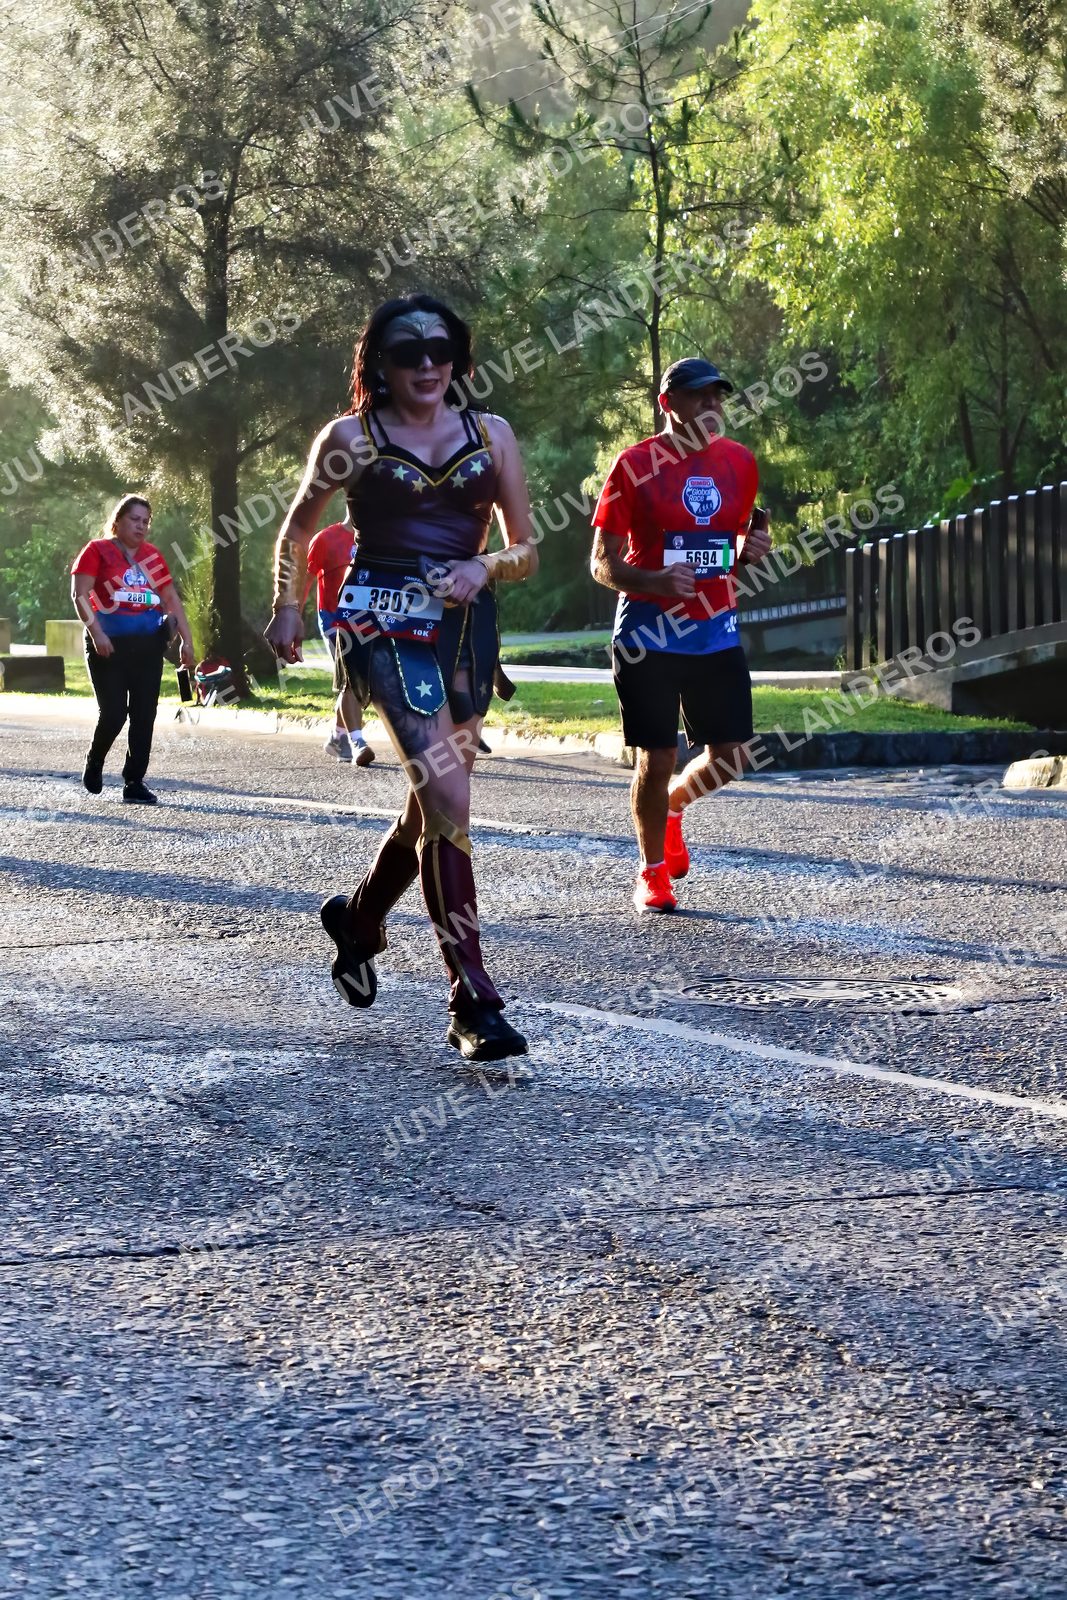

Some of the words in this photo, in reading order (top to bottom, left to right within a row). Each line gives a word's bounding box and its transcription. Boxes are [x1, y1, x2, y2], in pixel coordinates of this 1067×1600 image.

[692, 488, 711, 496] Global
[689, 494, 705, 502] Race
[686, 551, 717, 565] 5694
[128, 593, 145, 602] 2881
[368, 588, 415, 615] 3907
[413, 629, 429, 637] 10K
